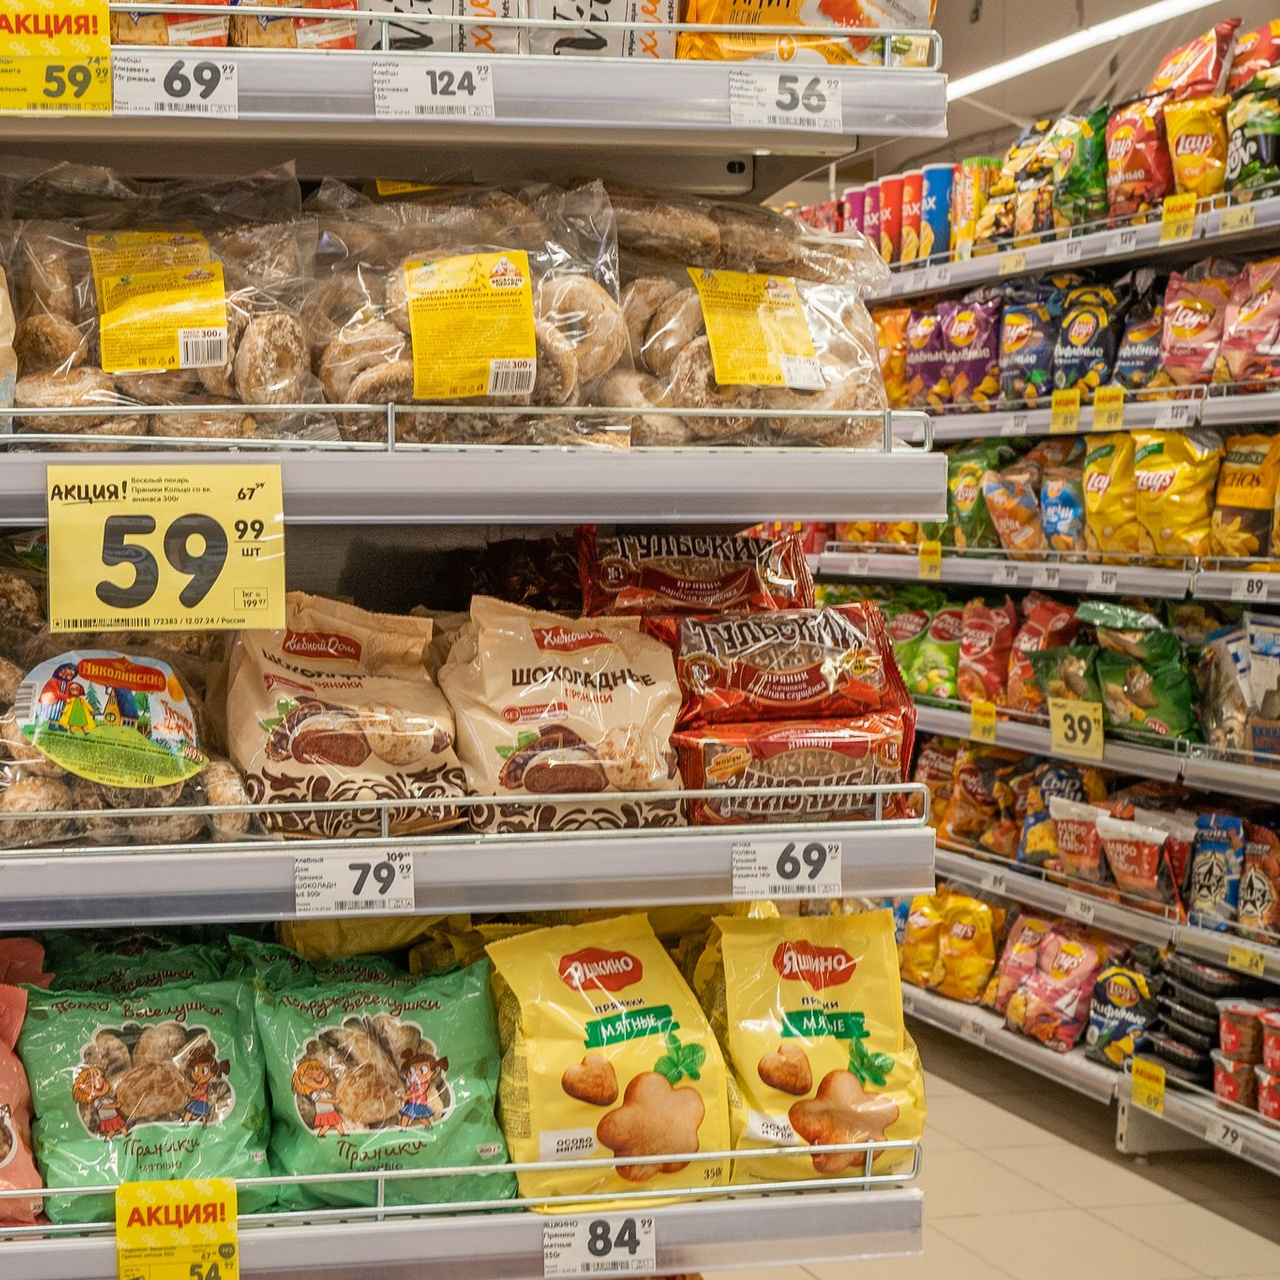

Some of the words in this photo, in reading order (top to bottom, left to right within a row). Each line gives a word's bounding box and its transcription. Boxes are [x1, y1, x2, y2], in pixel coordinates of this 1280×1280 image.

[43, 65, 91, 98] 59
[95, 69, 108, 77] 99
[163, 60, 221, 99] 69
[222, 64, 234, 73] 99
[426, 71, 475, 96] 124
[776, 75, 826, 113] 56
[51, 481, 128, 503] АКЦИЯ!
[237, 488, 255, 500] 67
[96, 513, 228, 608] 59
[234, 520, 264, 540] 99
[242, 548, 261, 557] шт
[1246, 581, 1264, 594] 89
[1064, 712, 1092, 742] 39
[777, 843, 826, 879] 69
[828, 844, 839, 853] 99
[349, 862, 395, 895] 79
[399, 864, 411, 873] 99
[1222, 1125, 1239, 1142] 79
[126, 1203, 225, 1228] АКЦИЯ!
[588, 1218, 640, 1256] 84
[641, 1219, 652, 1228] 99
